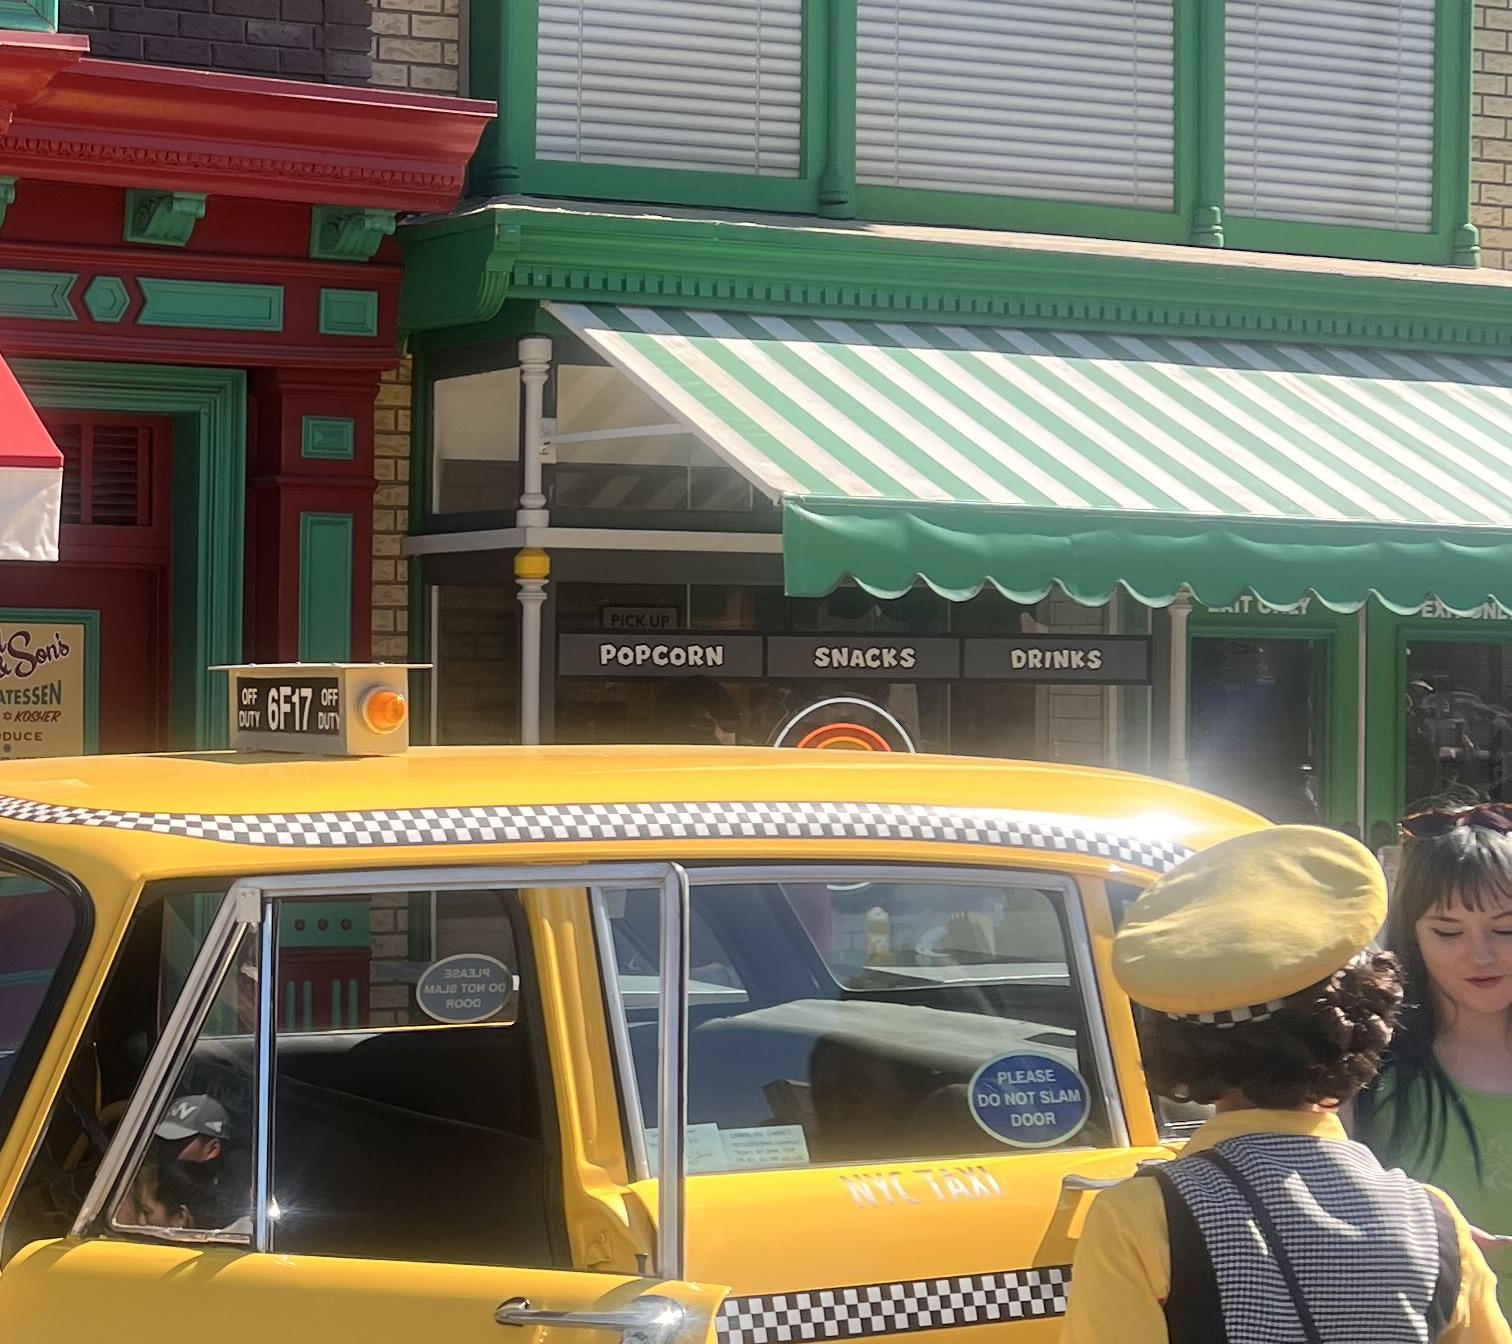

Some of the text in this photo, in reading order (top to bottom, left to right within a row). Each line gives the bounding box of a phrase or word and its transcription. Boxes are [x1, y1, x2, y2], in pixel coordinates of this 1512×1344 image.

[611, 613, 670, 628] PICK UP
[8, 630, 70, 678] Son's
[599, 642, 724, 668] POPCORN
[813, 647, 916, 668] SNACKS
[1010, 649, 1102, 669] DRINKS
[14, 710, 61, 722] KOSHER
[242, 686, 338, 731] OFF 6F17 OFF
[239, 710, 340, 729] DUTY DUTY
[997, 1069, 1056, 1085] PLEASE
[977, 1089, 1081, 1107] DO NOT SLAM
[1010, 1112, 1056, 1127] DOOR
[839, 1165, 1002, 1209] NYC TAXI
